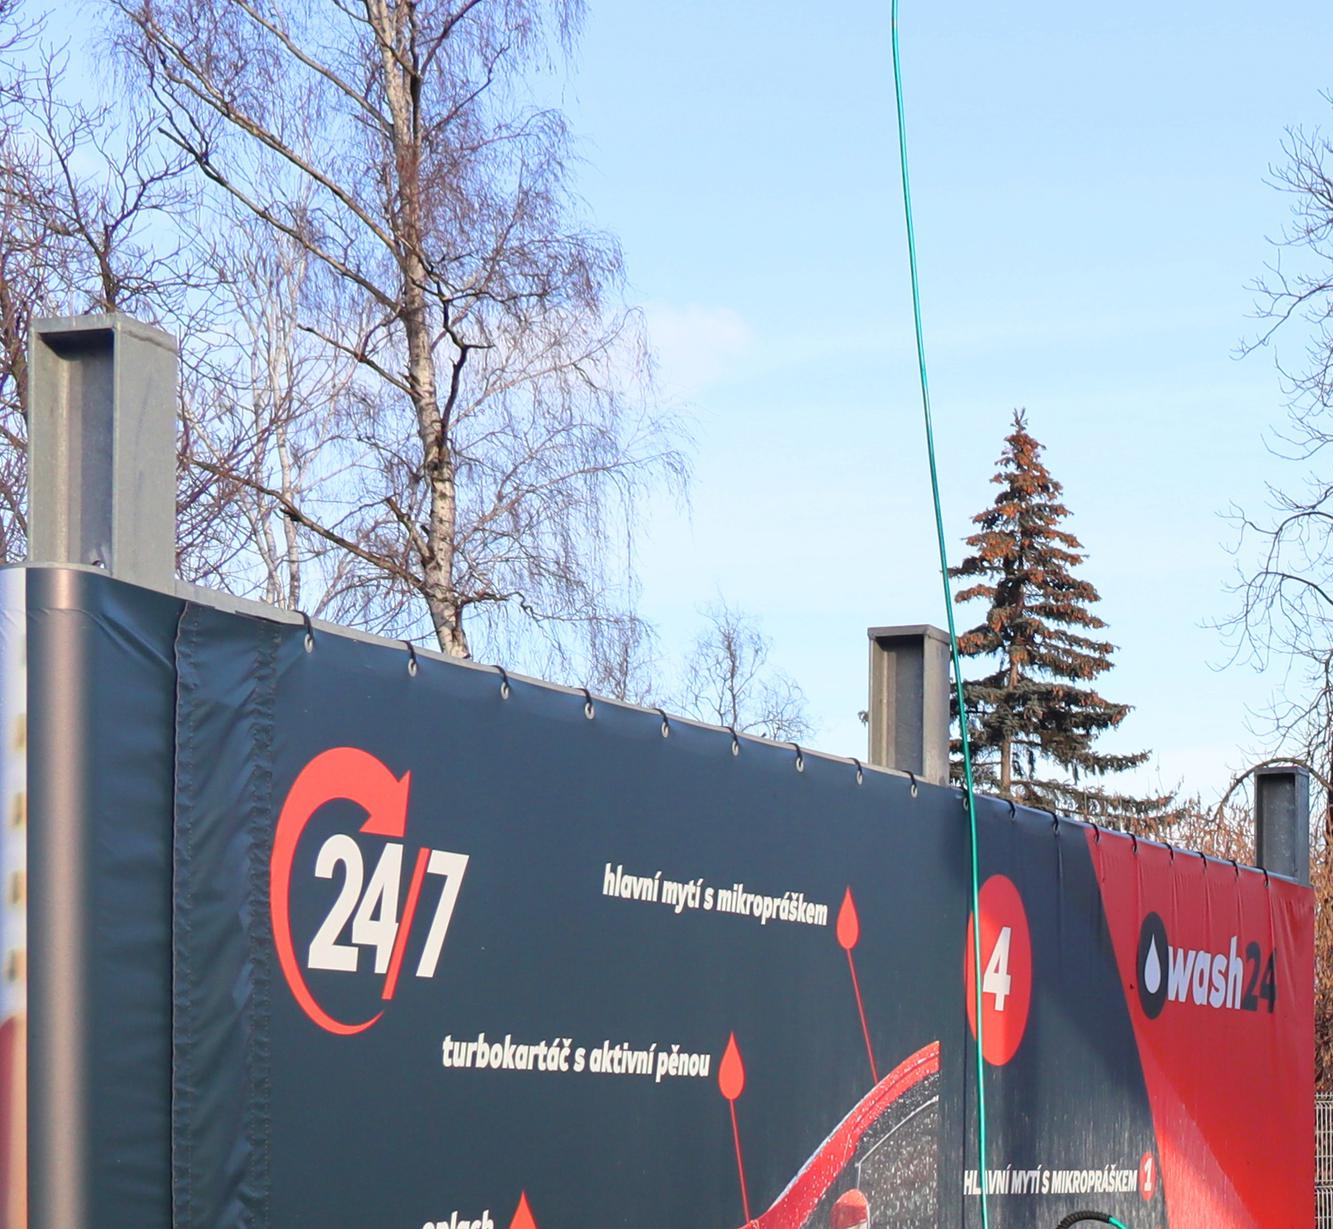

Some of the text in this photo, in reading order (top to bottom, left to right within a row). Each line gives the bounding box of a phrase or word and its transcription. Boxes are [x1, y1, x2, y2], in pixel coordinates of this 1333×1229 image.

[307, 833, 470, 1000] 24/7
[602, 862, 829, 926] hlavní mytí s mikropráškem
[982, 926, 1012, 1012] 4
[1167, 935, 1278, 1014] wash24
[441, 1032, 711, 1083] turbokartáč s aktivní pěnou
[1010, 1164, 1041, 1195] MYTÍ
[1041, 1169, 1050, 1195] S
[1050, 1163, 1138, 1195] MIKROPRÁŠKEM
[1143, 1157, 1153, 1192] 1
